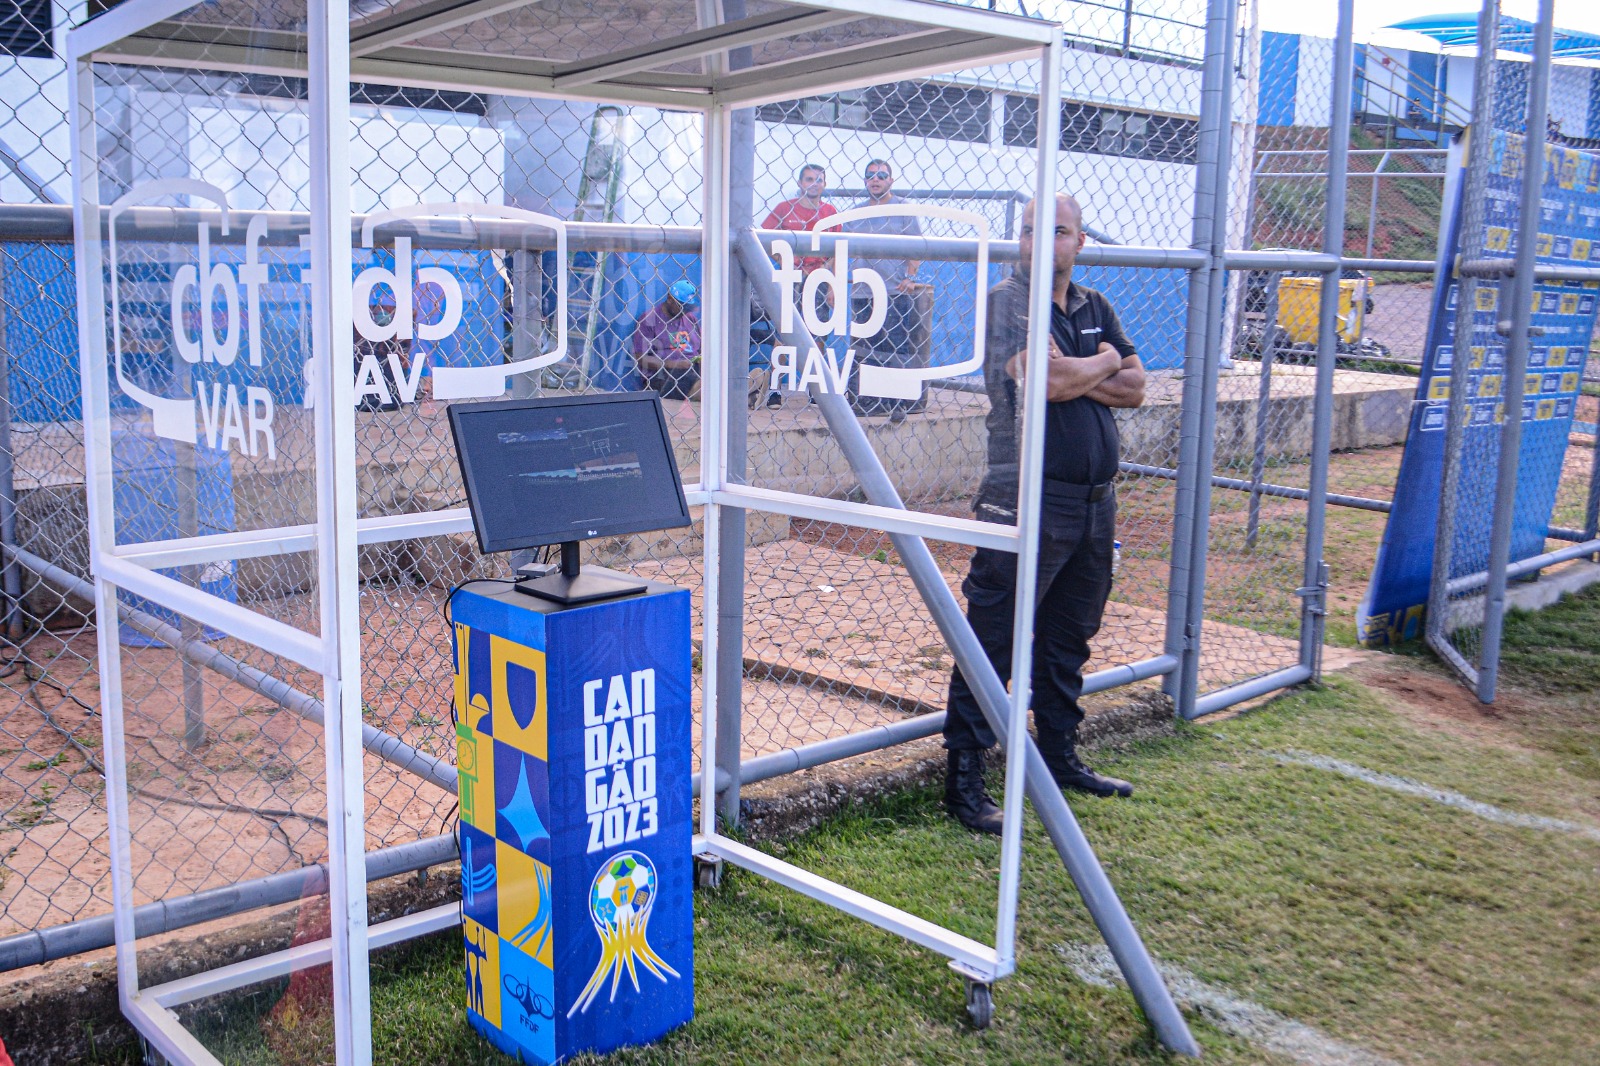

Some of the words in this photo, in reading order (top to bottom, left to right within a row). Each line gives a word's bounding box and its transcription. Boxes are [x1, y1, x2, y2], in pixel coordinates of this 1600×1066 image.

[172, 215, 268, 367] cbf
[197, 381, 276, 461] VAR
[584, 668, 655, 727] CAN
[584, 713, 656, 771] DAN
[585, 755, 656, 814] GÃO
[587, 797, 658, 854] 2023
